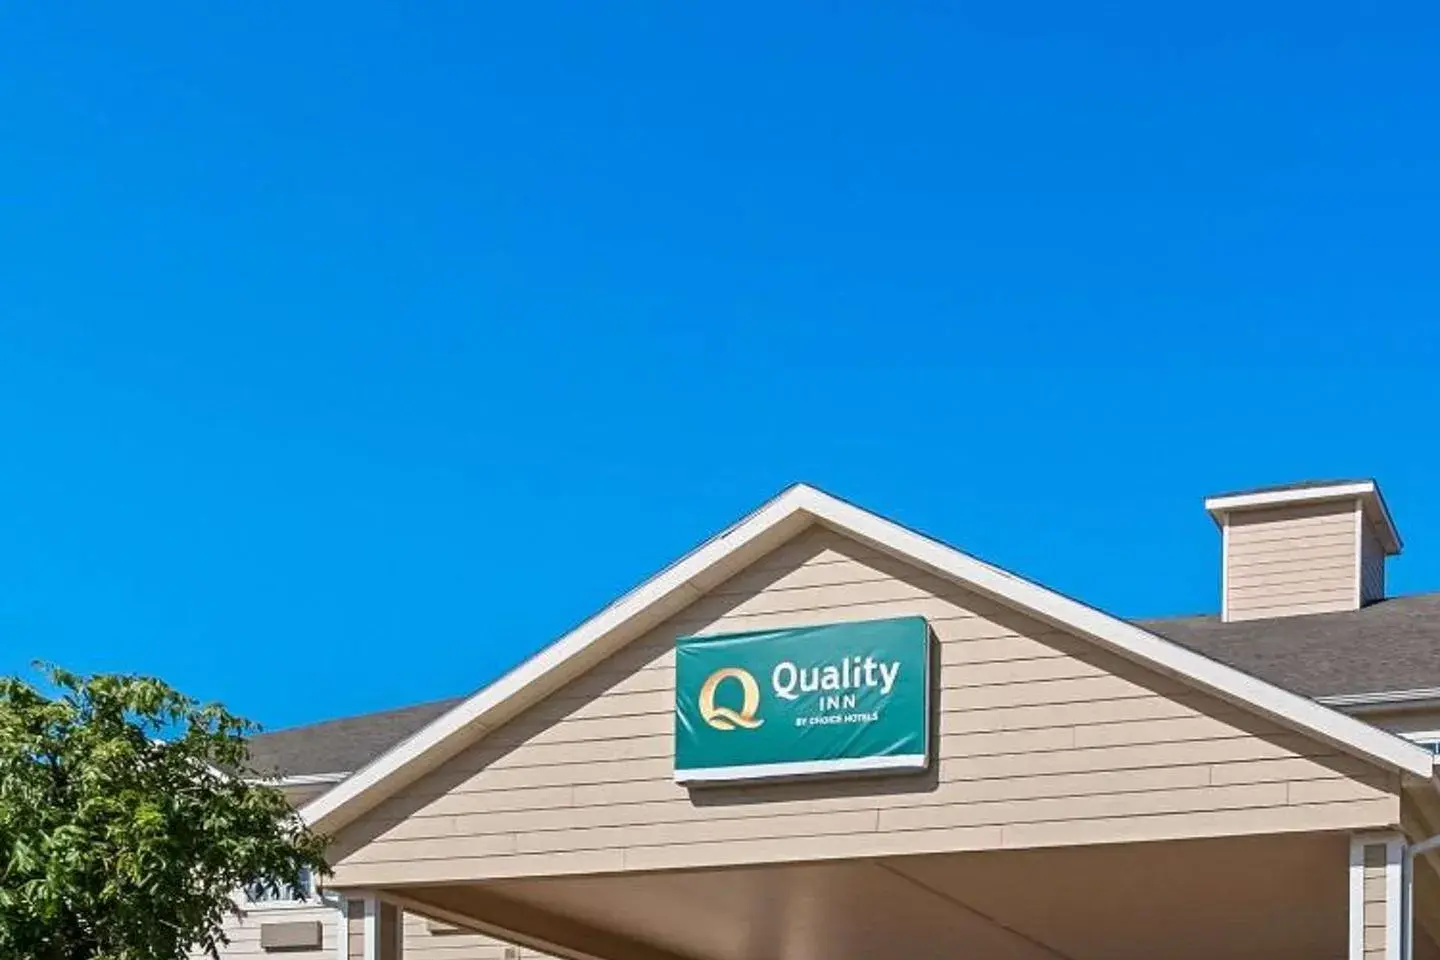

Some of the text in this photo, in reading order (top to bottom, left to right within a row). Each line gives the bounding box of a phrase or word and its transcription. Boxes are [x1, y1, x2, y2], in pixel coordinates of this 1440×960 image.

[773, 656, 900, 700] Quality
[699, 667, 764, 731] Q
[819, 695, 856, 711] INN
[795, 716, 808, 727] BY
[844, 711, 879, 724] HOTELS
